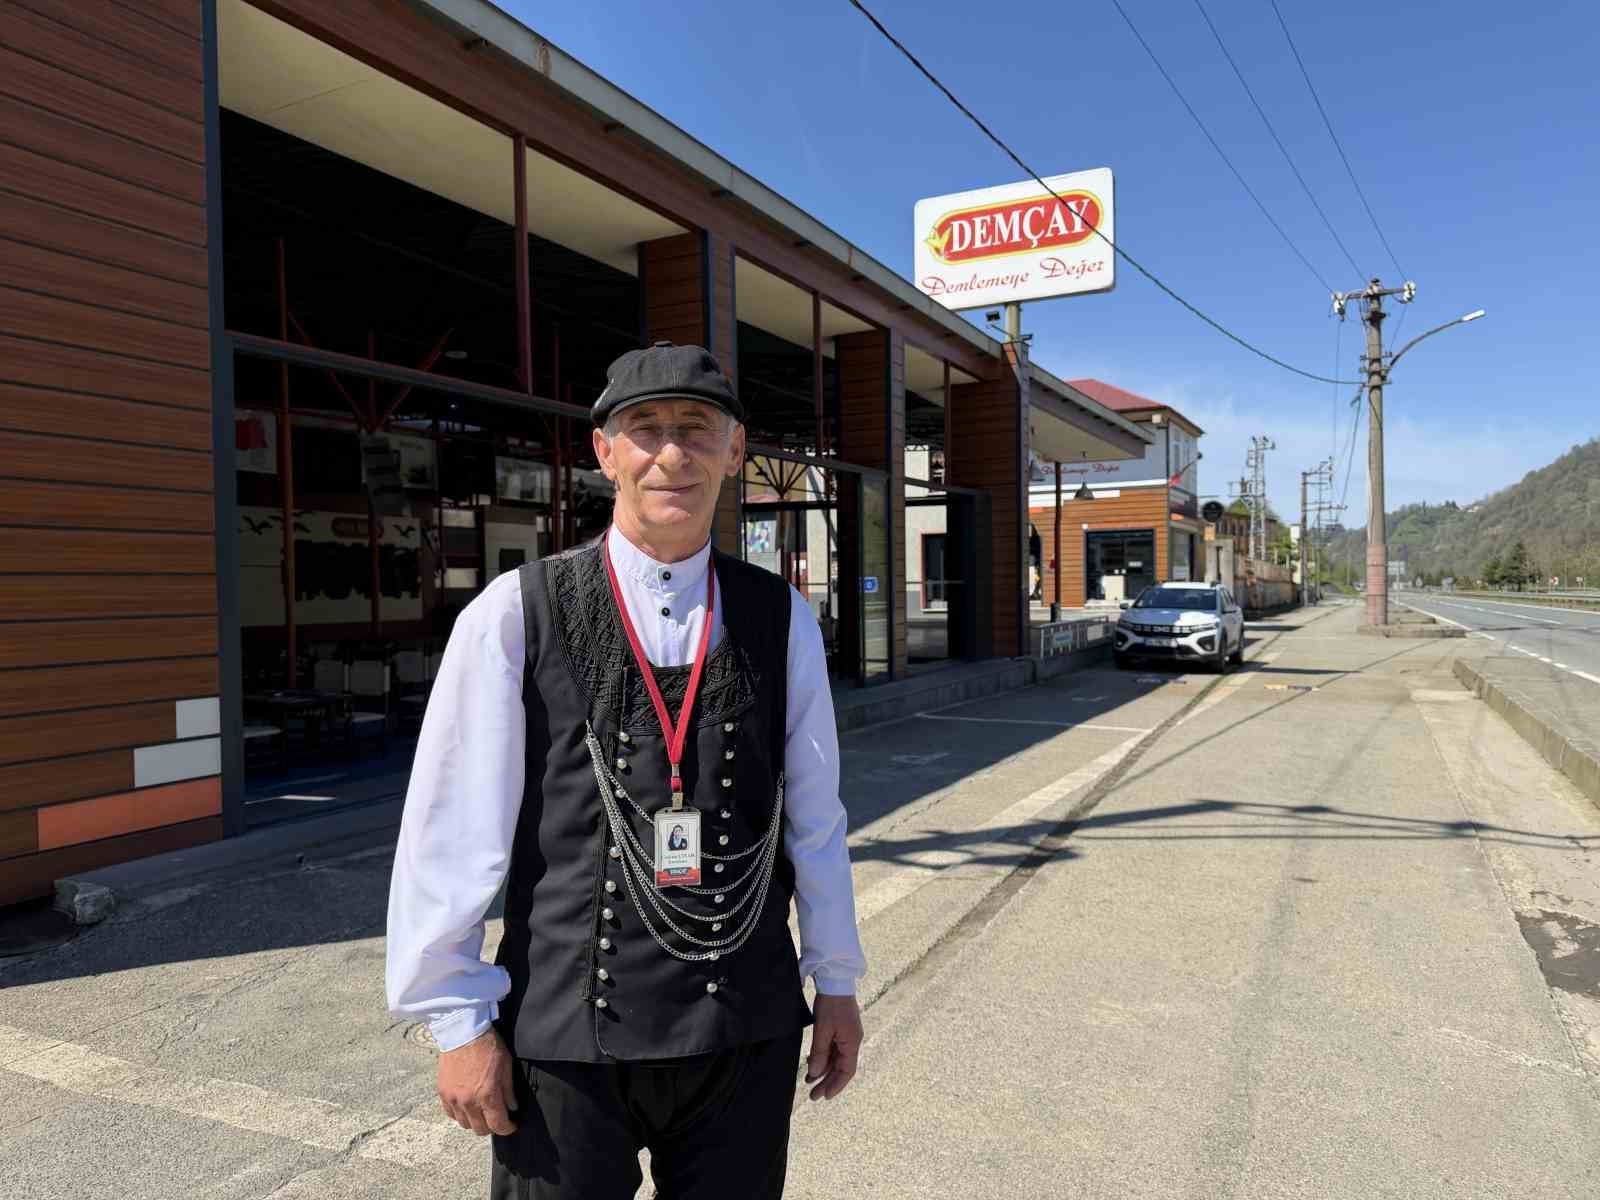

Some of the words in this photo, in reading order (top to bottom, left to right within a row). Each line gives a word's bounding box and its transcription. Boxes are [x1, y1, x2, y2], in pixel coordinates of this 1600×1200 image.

[951, 199, 1090, 252] DEMÇAY
[921, 271, 1030, 296] Demlemeye
[1039, 257, 1104, 279] Değer
